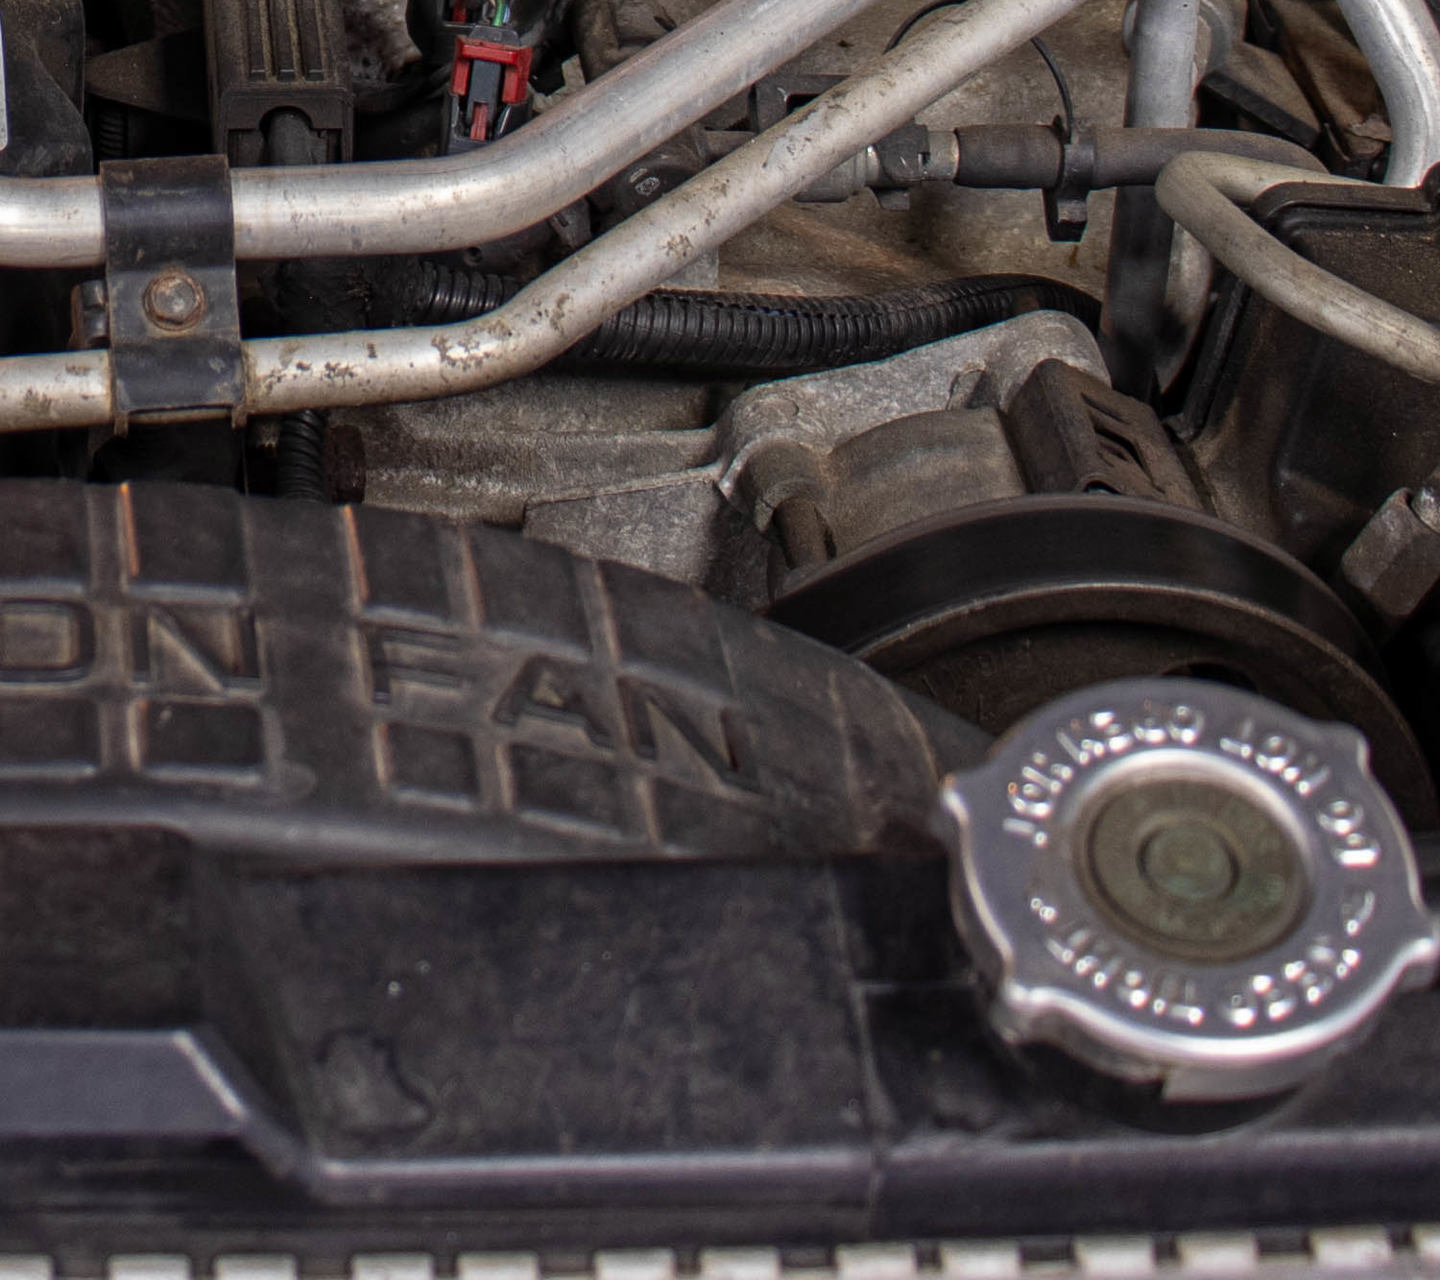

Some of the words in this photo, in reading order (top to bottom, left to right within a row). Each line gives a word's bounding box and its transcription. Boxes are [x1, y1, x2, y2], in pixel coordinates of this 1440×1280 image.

[365, 622, 765, 792] FAN
[1055, 704, 1205, 767] OPEN
[1220, 715, 1332, 796] NOT
[1317, 798, 1380, 868] DO
